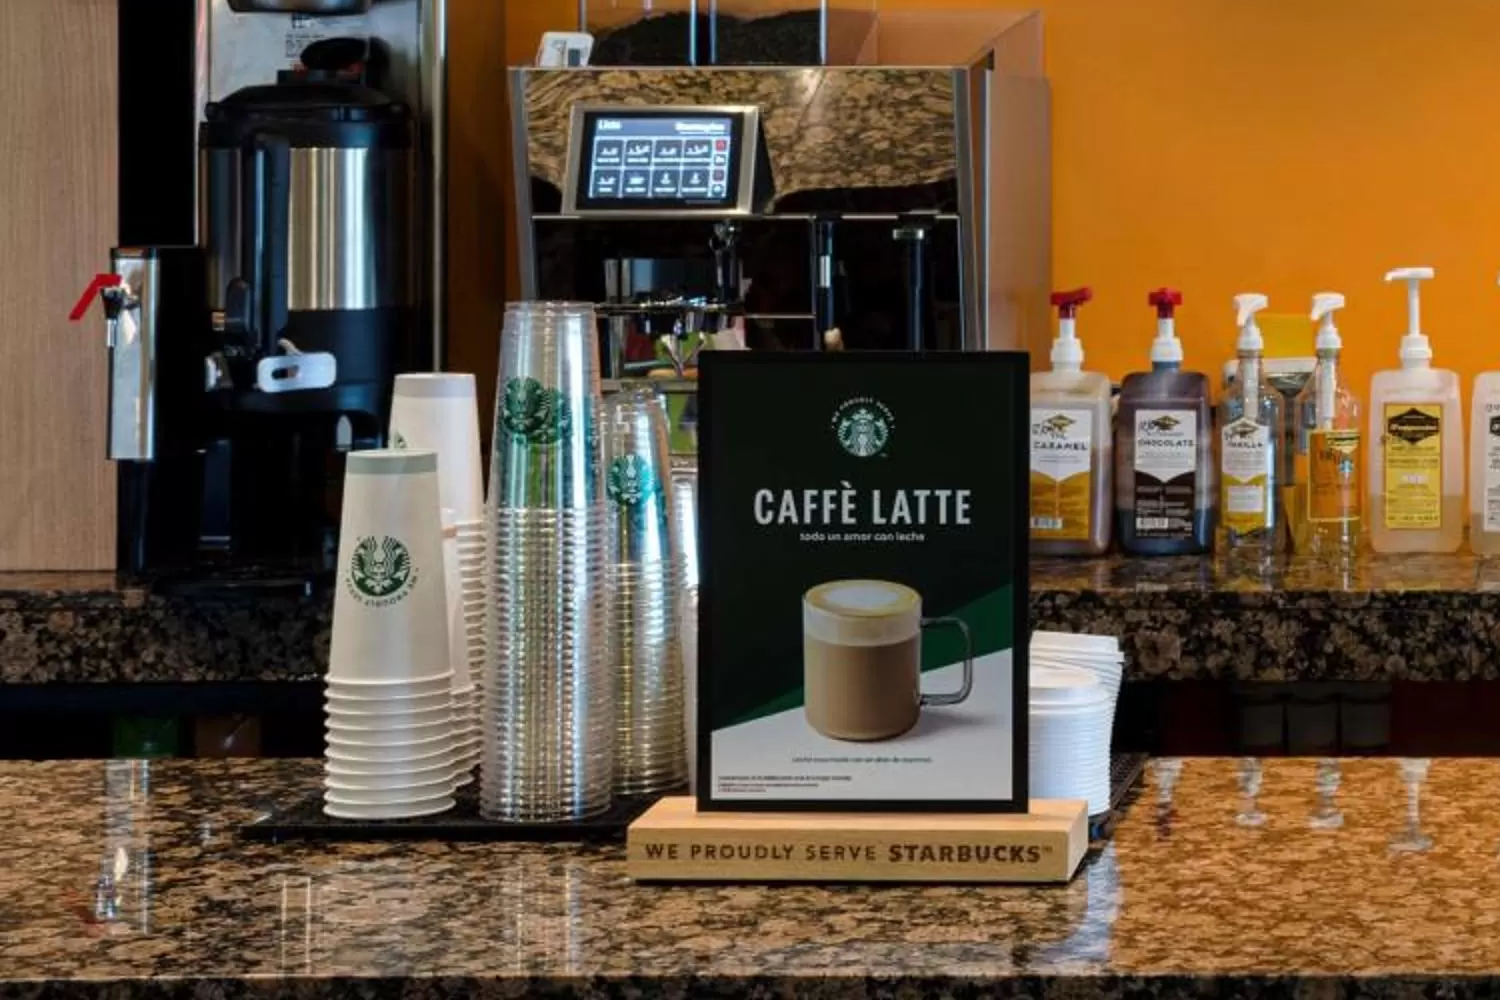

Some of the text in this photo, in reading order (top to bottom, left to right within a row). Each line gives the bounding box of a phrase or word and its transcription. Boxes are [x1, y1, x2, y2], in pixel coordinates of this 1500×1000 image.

[753, 481, 971, 525] CAFFÈ LATTE
[800, 531, 925, 542] todo un amor con leche
[646, 843, 679, 860] WE
[690, 843, 794, 861] PROUDLY
[805, 844, 876, 861] SERVE
